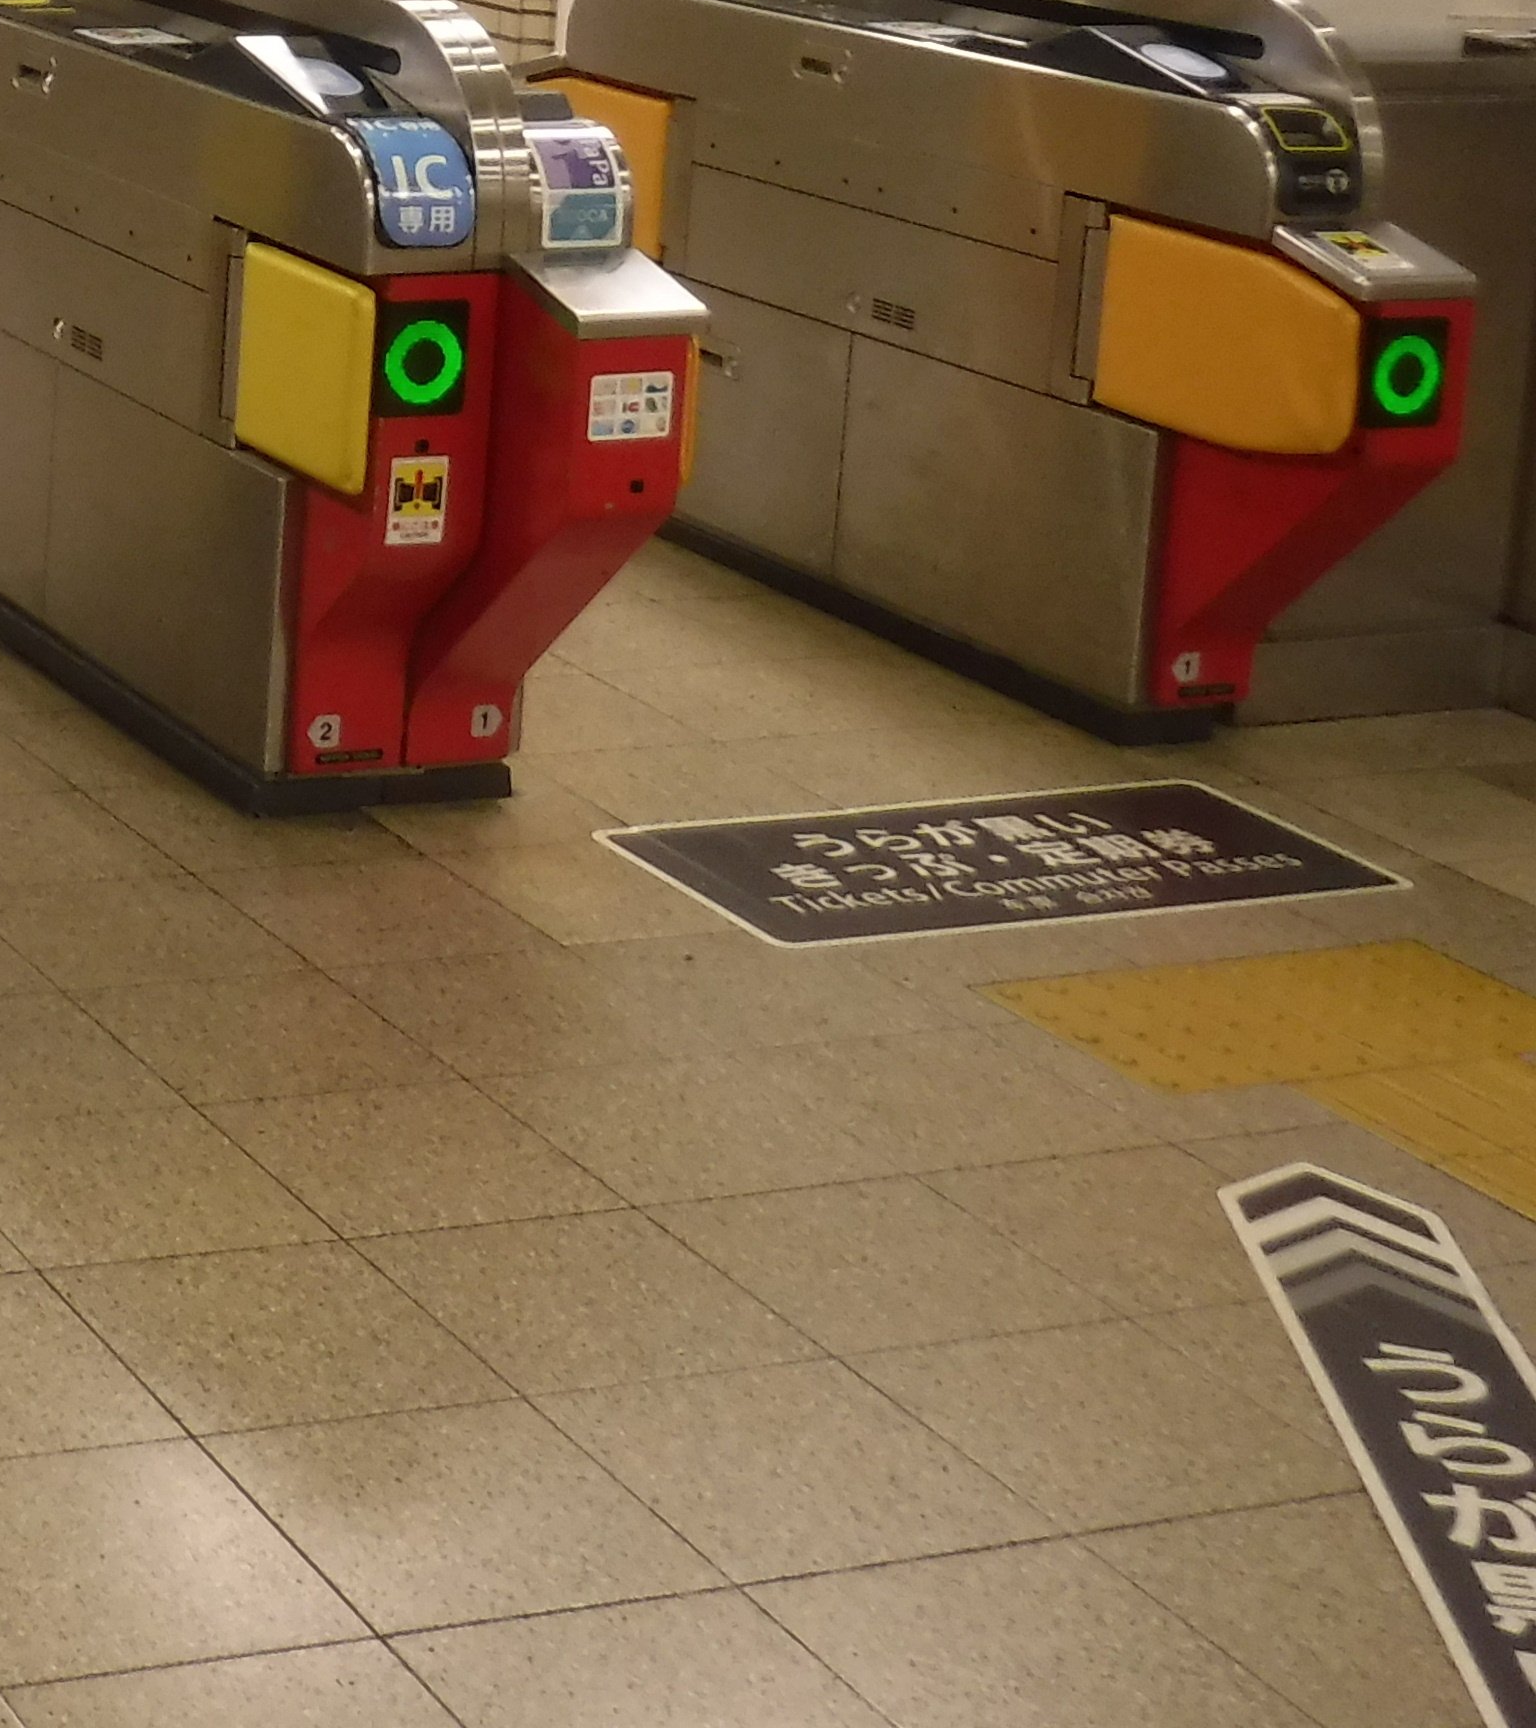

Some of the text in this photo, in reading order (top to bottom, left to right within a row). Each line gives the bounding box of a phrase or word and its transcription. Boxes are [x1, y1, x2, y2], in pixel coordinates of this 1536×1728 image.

[391, 154, 455, 201] IC
[397, 205, 456, 234] 専用
[1184, 660, 1191, 675] 1
[319, 722, 333, 741] 2
[480, 711, 489, 730] 1
[792, 811, 1113, 859] うらが黒い
[768, 853, 1304, 915] Tickets/Commuter Passes
